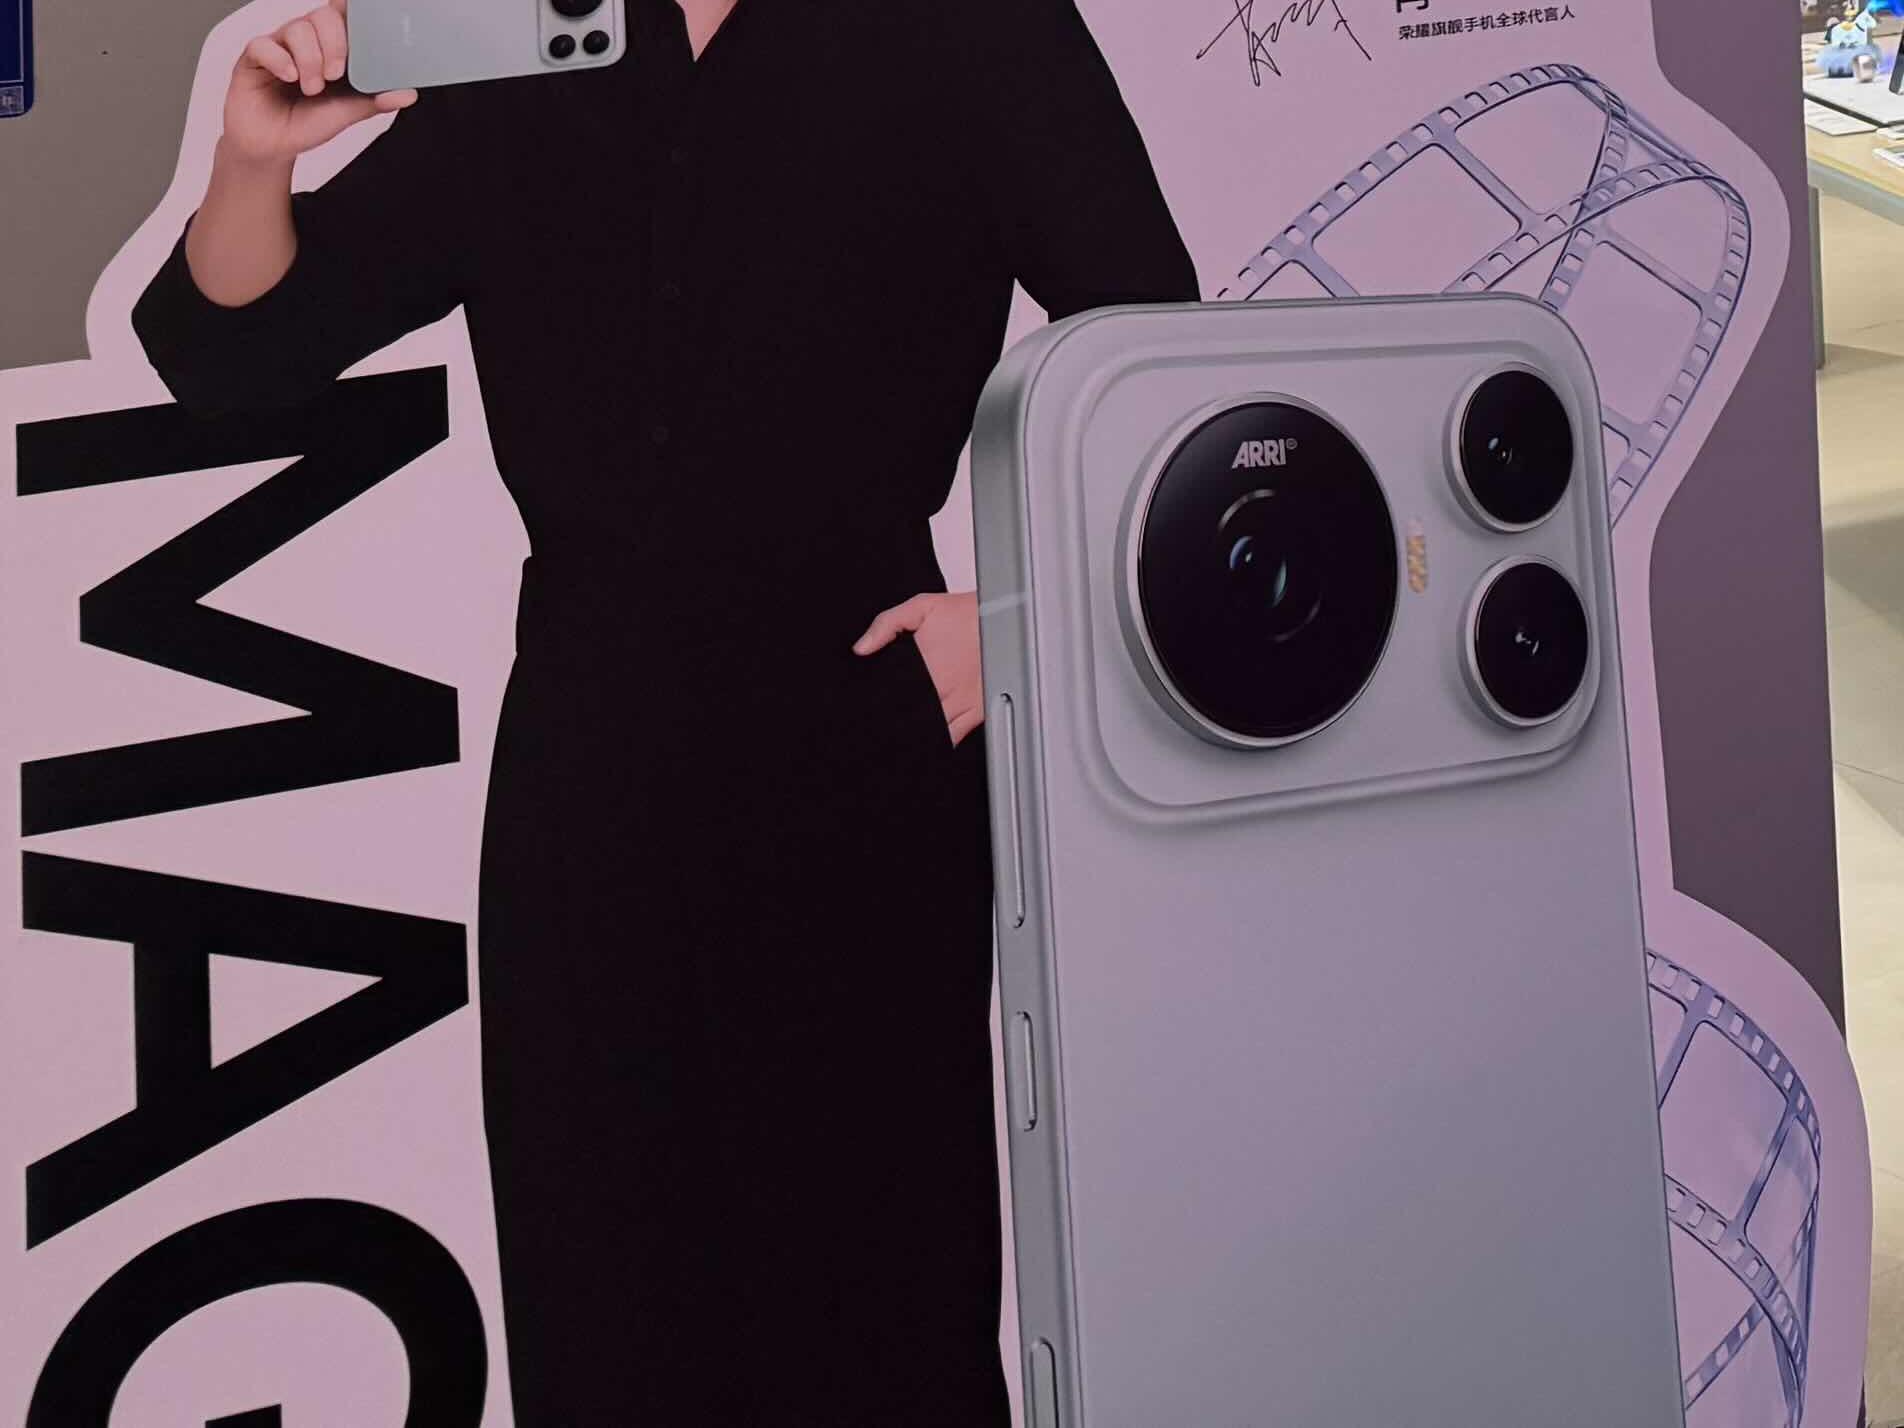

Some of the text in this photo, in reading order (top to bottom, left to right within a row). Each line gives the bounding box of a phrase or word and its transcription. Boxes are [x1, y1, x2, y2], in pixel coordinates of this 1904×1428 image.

[1398, 5, 1576, 40] 荣耀旗舰手机全球代言人
